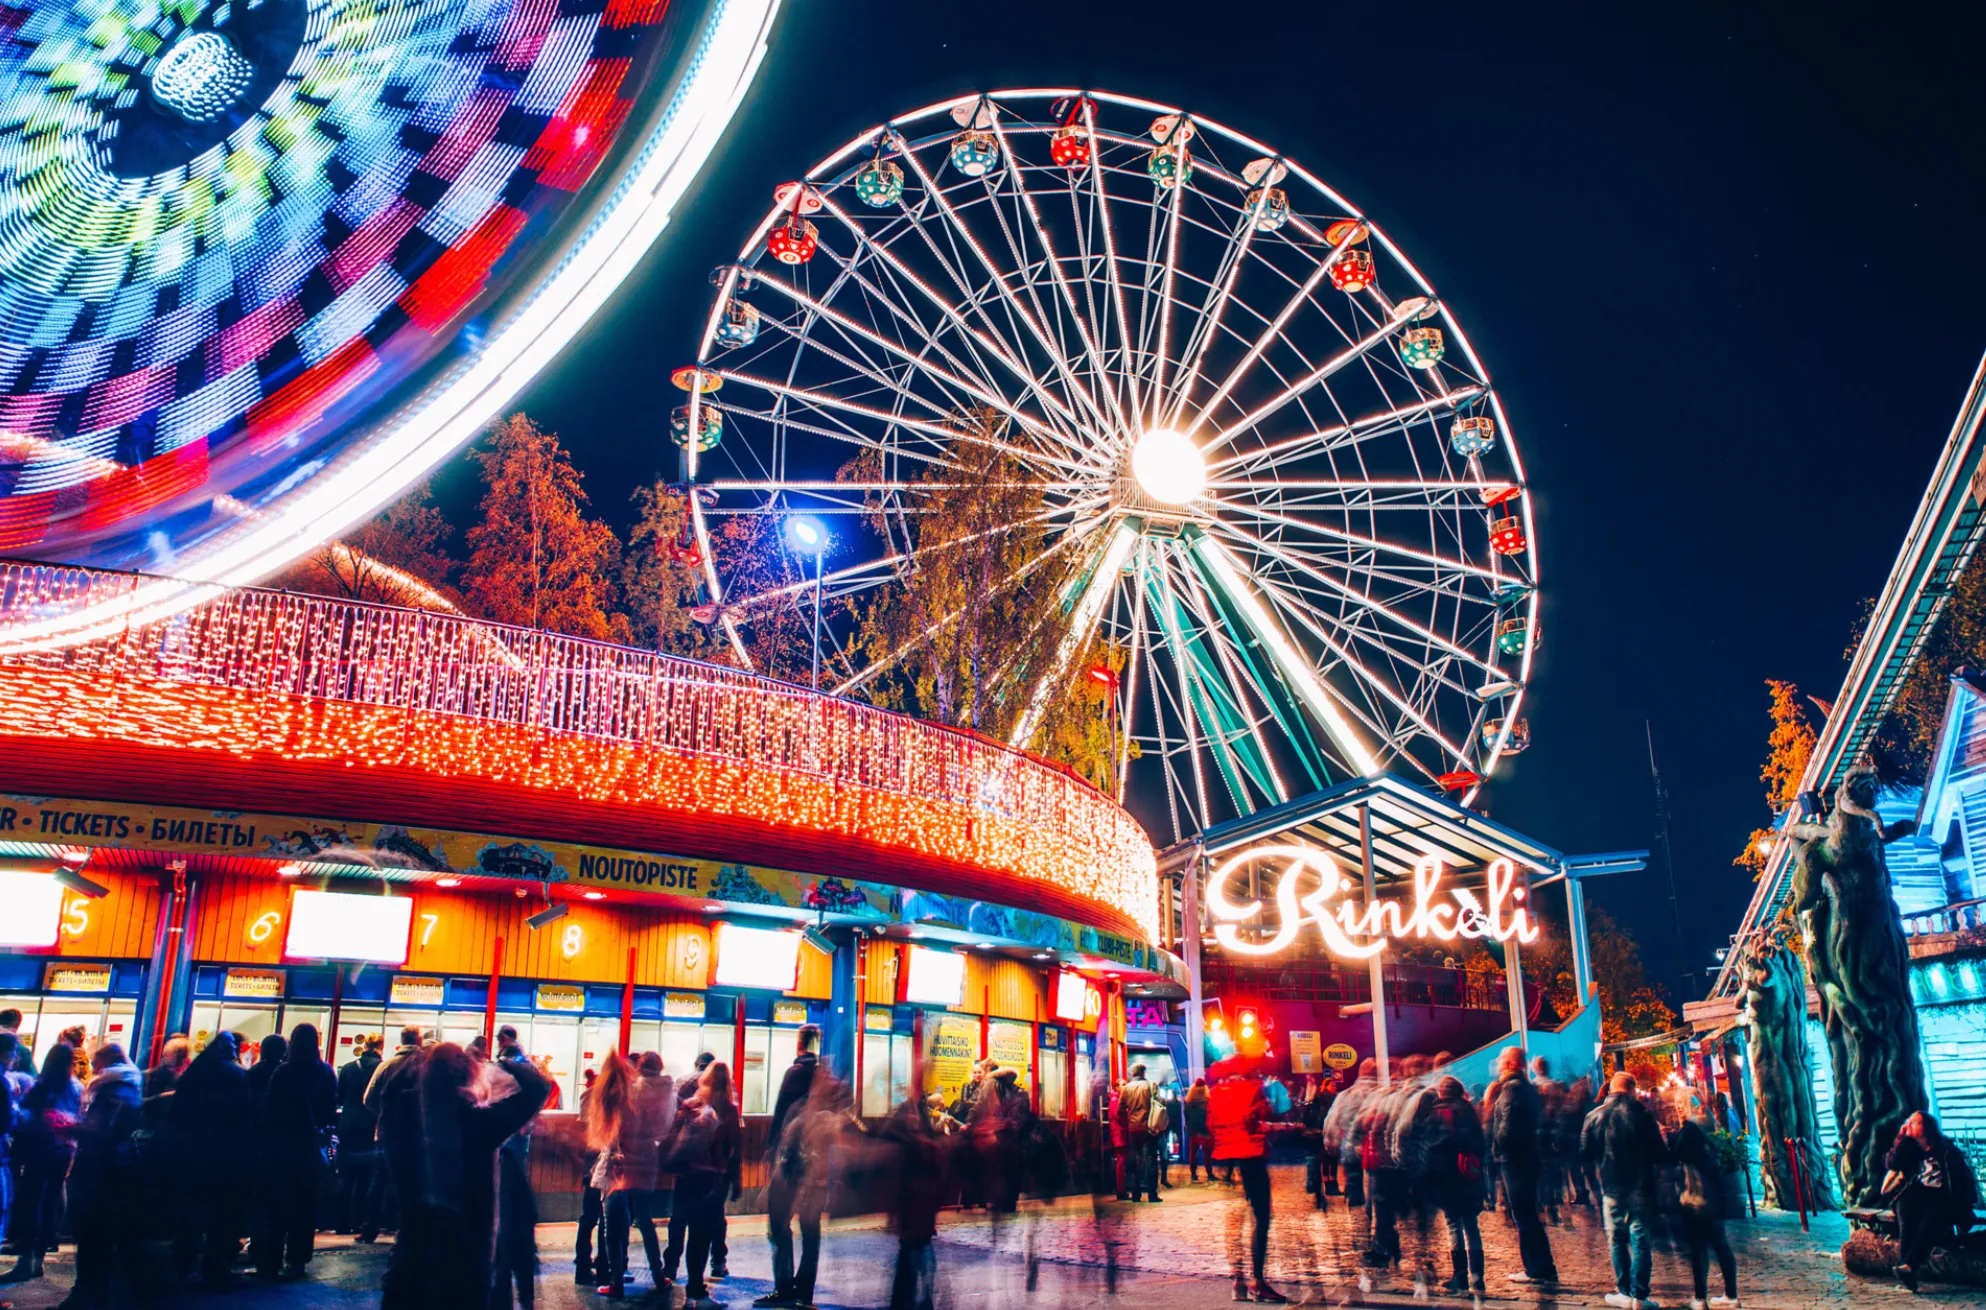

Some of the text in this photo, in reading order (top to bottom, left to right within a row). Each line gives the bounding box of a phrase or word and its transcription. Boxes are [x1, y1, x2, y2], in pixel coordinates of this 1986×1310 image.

[40, 810, 130, 838] TICKETS
[151, 818, 255, 847] БИЛЕТЫ
[579, 854, 698, 890] NOUTOPISTE
[1206, 845, 1540, 958] Rinkeli
[250, 911, 281, 941] 6
[421, 914, 438, 945] 7
[562, 924, 582, 958] 8
[684, 935, 702, 970] 9
[541, 993, 579, 1003] NOUTOPISTE
[1328, 1051, 1352, 1060] RINKELI
